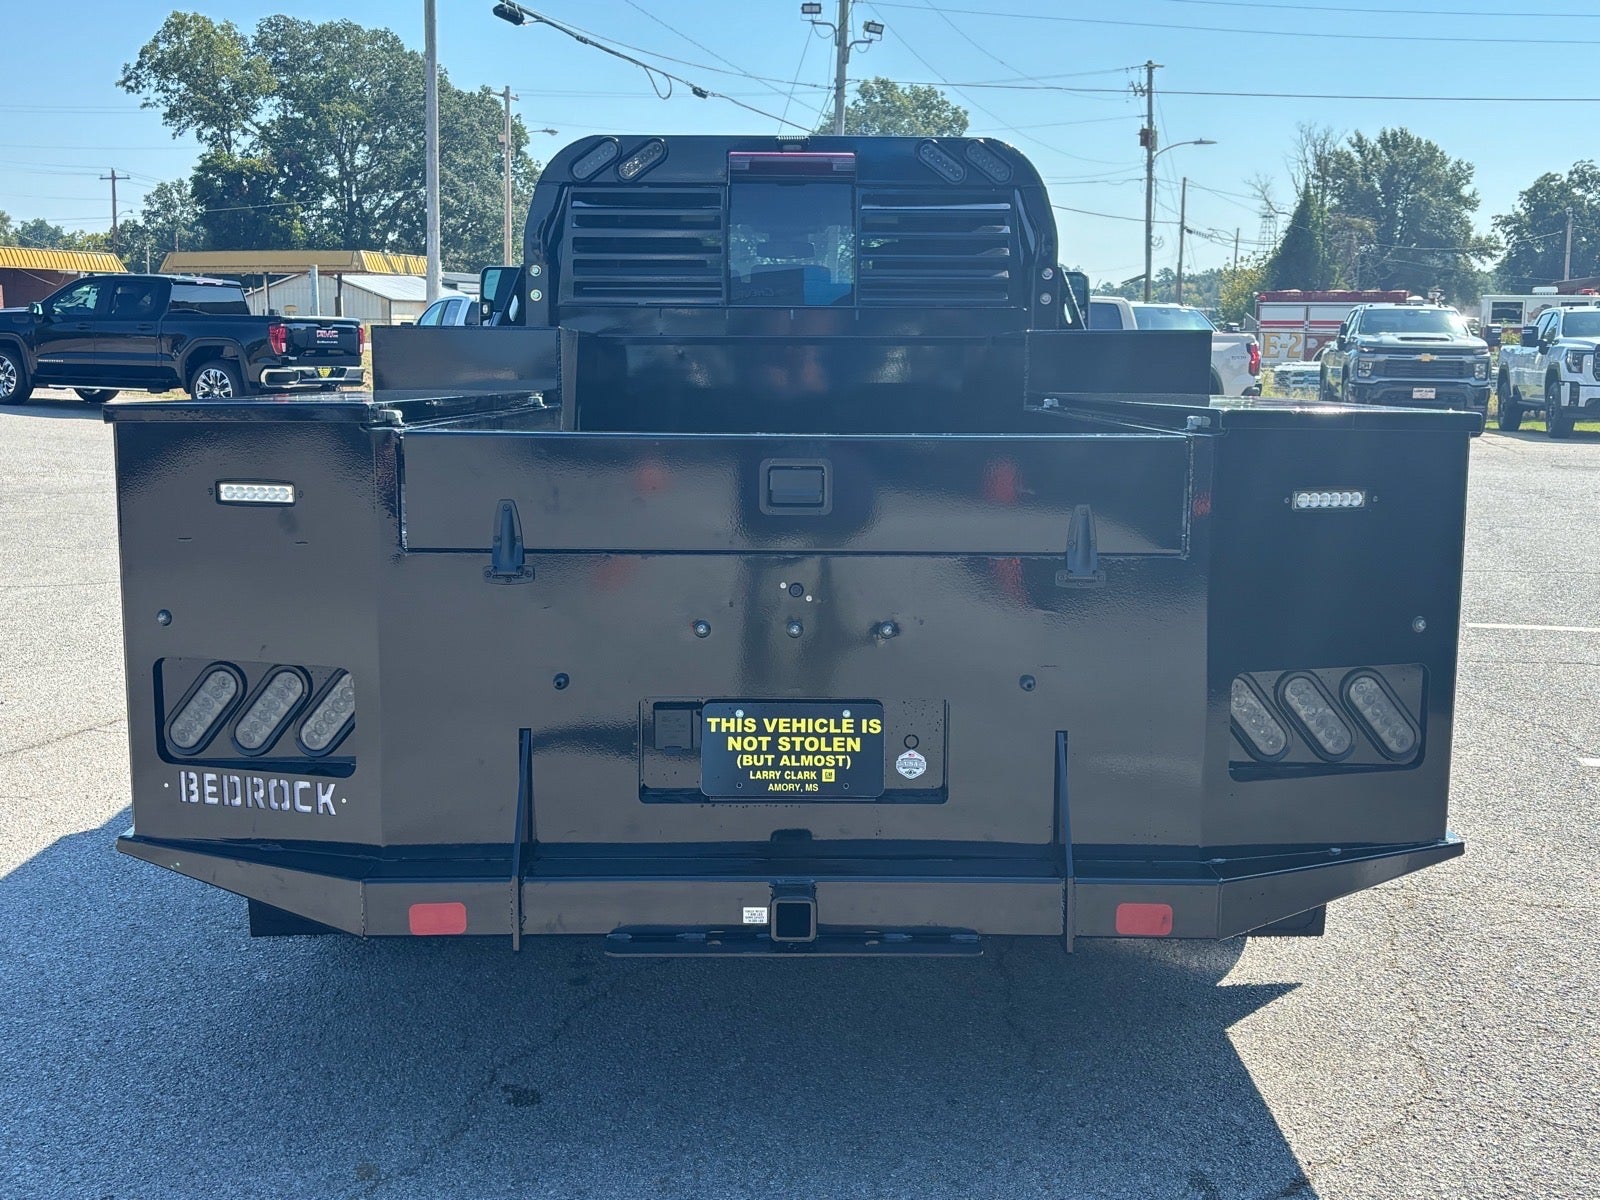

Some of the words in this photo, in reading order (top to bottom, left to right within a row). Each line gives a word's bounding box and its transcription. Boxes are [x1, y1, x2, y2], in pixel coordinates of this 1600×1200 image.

[316, 330, 339, 338] GMC
[1263, 332, 1302, 358] E-2
[707, 717, 757, 733] THIS
[763, 717, 855, 734] VEHICLE
[861, 718, 882, 734] IS
[727, 736, 772, 752] NOT
[777, 736, 861, 752] STOLEN
[736, 754, 775, 769] (BUT
[779, 754, 851, 770] ALMOST)
[749, 770, 781, 780] LARRY
[784, 770, 817, 780] CLARK
[178, 770, 337, 816] BEDROCK
[767, 783, 803, 793] AMORY,
[805, 783, 819, 792] MS
